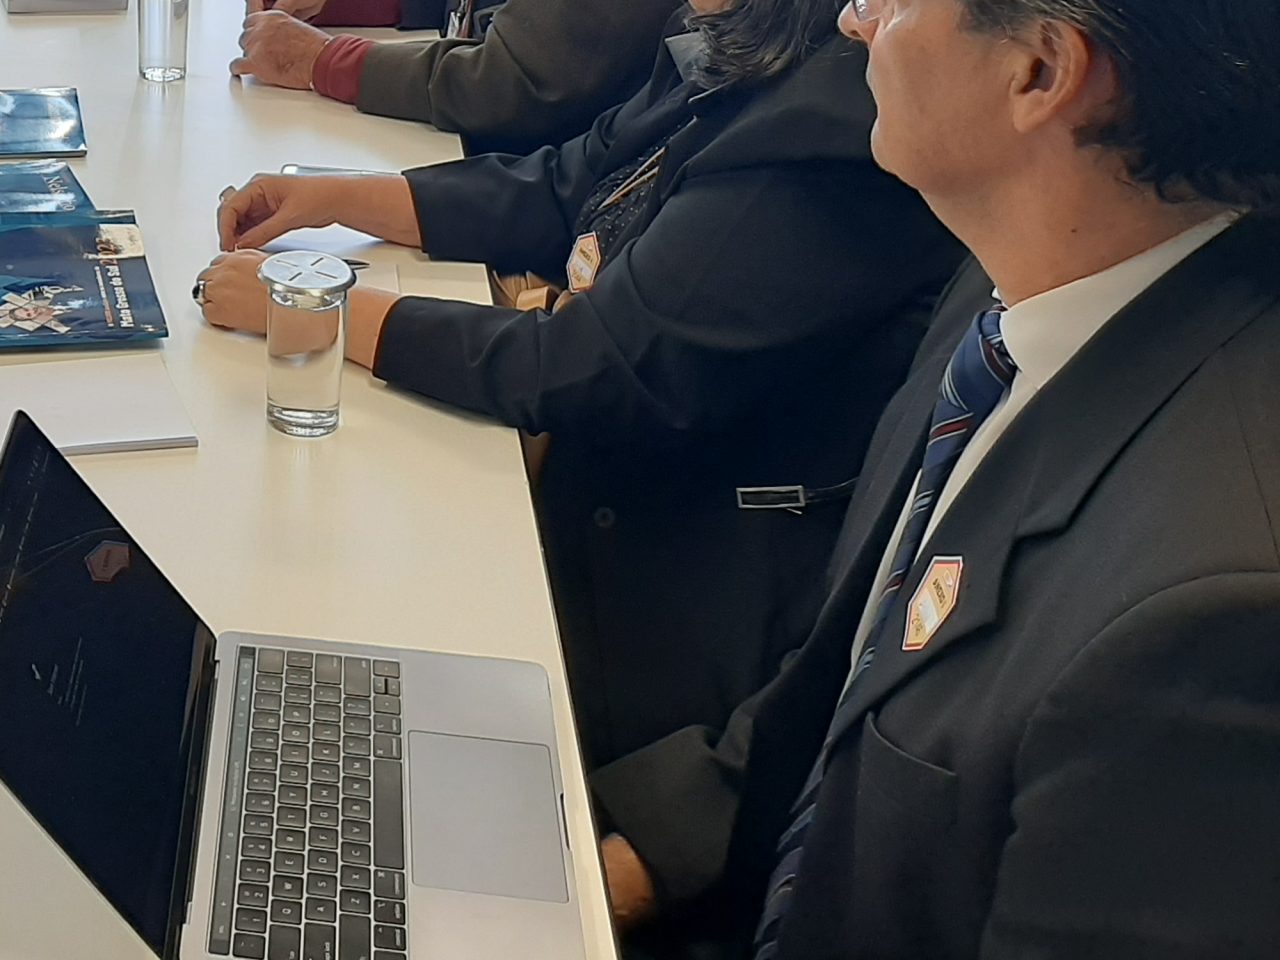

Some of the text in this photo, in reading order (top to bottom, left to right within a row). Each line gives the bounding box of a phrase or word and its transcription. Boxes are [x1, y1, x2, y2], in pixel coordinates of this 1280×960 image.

[110, 276, 122, 284] do
[114, 285, 129, 309] Grosso
[118, 309, 134, 327] Mato
